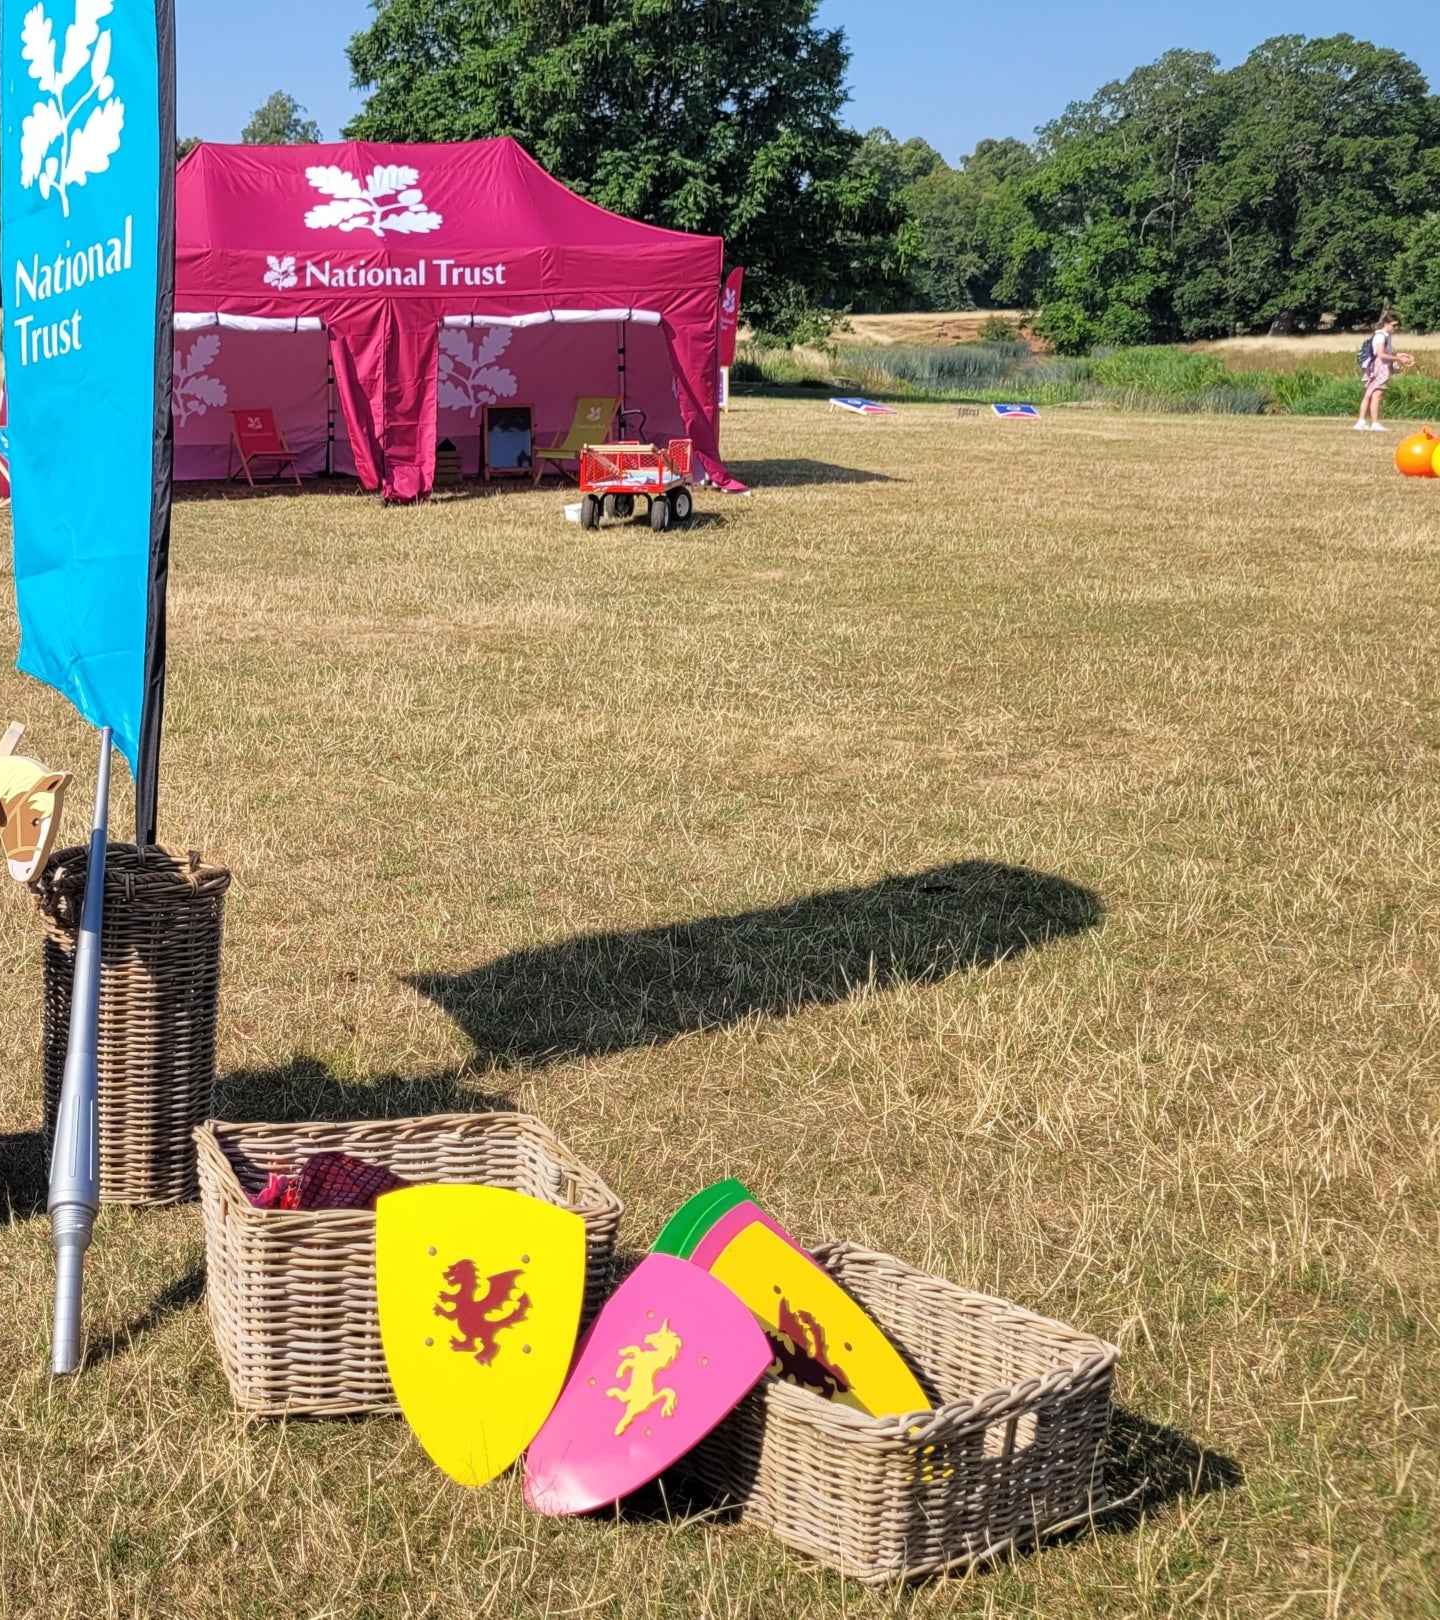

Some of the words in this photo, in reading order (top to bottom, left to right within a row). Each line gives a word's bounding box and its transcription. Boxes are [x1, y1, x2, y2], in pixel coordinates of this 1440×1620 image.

[15, 214, 132, 308] National
[305, 259, 426, 287] National
[432, 259, 506, 286] Trust
[14, 309, 82, 366] Trust
